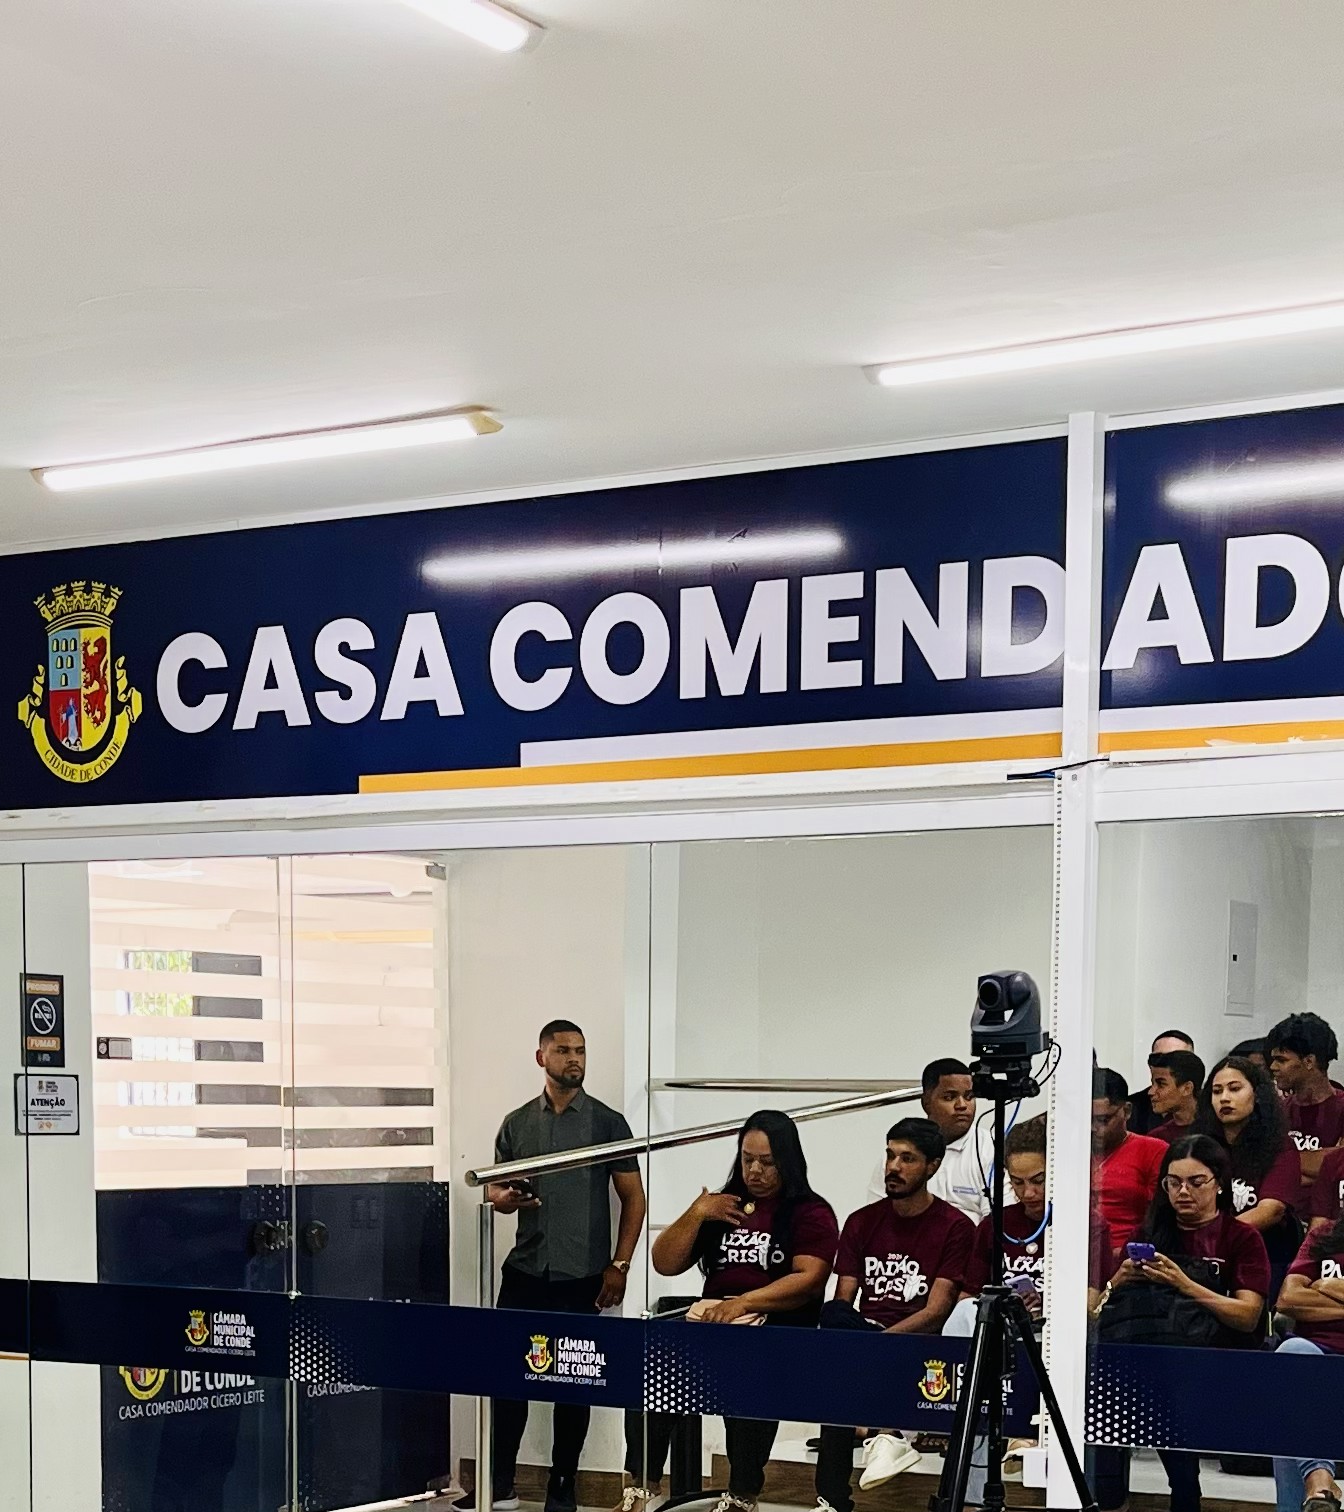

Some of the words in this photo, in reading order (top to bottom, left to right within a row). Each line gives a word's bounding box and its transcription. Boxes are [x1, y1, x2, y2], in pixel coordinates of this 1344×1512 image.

[155, 611, 464, 733] CASA
[44, 748, 77, 781] CIDADE
[80, 768, 92, 781] DE
[94, 740, 122, 777] CONDE
[30, 1096, 65, 1109] ATENÇÃO
[213, 1311, 246, 1325] CÂMARA
[213, 1324, 255, 1337] MUNICIPAL
[213, 1336, 224, 1346] DE
[225, 1337, 251, 1348] CONDE
[558, 1337, 595, 1352] CÂMARA
[558, 1350, 606, 1365] MUNICIPAL
[558, 1363, 569, 1374] DE
[571, 1364, 601, 1377] CONDE
[181, 1370, 201, 1394] DE
[307, 1383, 329, 1398] CASA
[119, 1404, 144, 1420] CASA
[146, 1397, 208, 1417] COMENDADOR
[243, 1390, 265, 1404] LEITE
[917, 1401, 932, 1409] CASA
